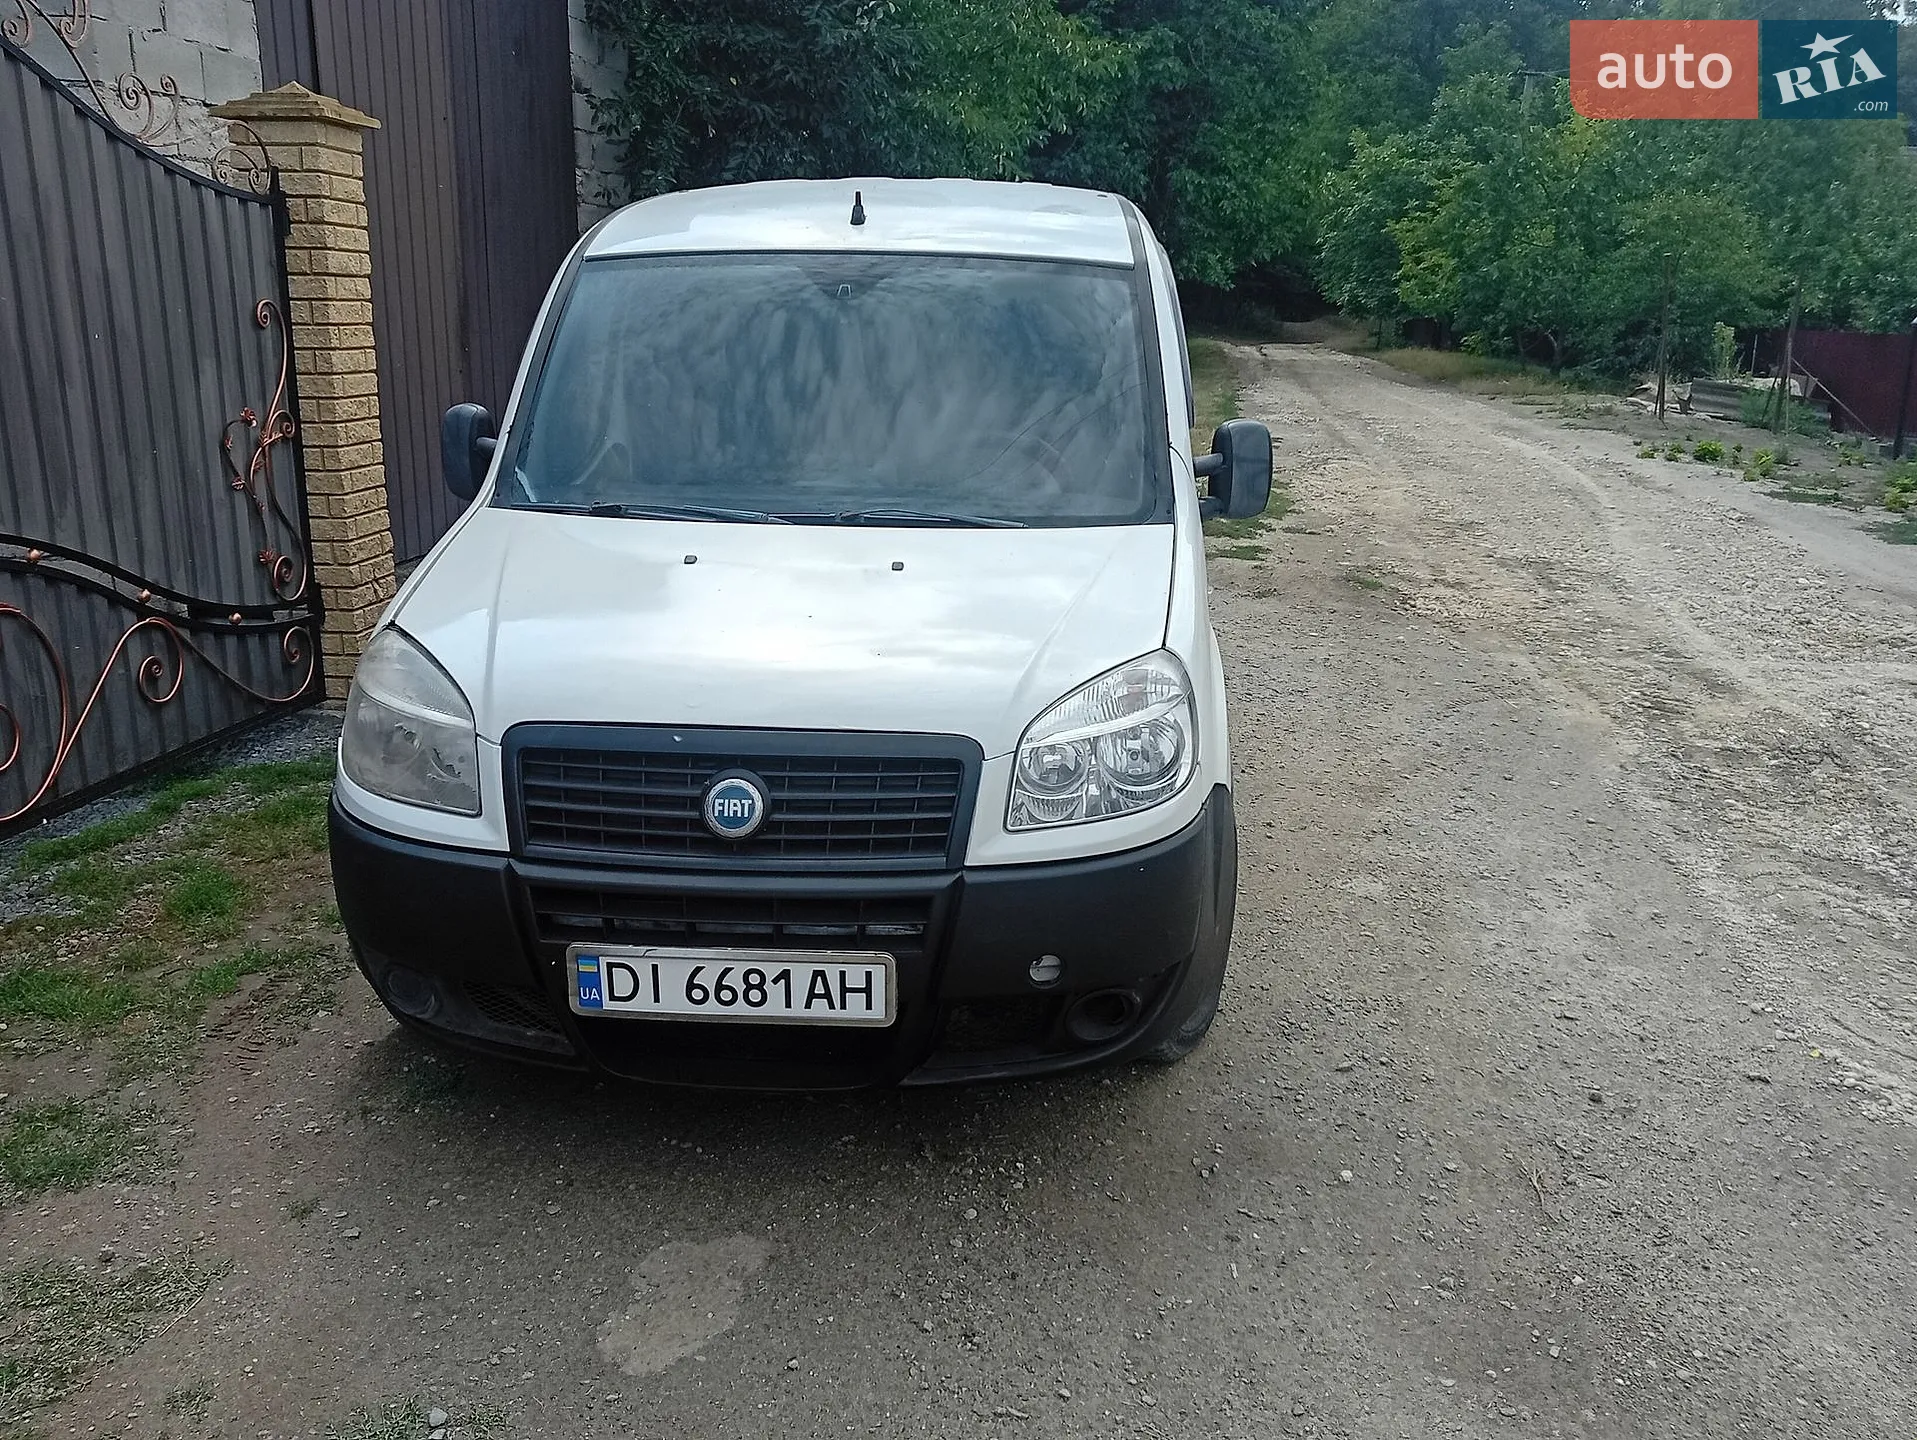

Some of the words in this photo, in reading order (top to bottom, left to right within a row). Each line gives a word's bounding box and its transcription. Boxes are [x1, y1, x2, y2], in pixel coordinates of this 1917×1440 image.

[714, 798, 752, 817] FIAT
[605, 961, 660, 1004] DI
[580, 986, 600, 1001] UA
